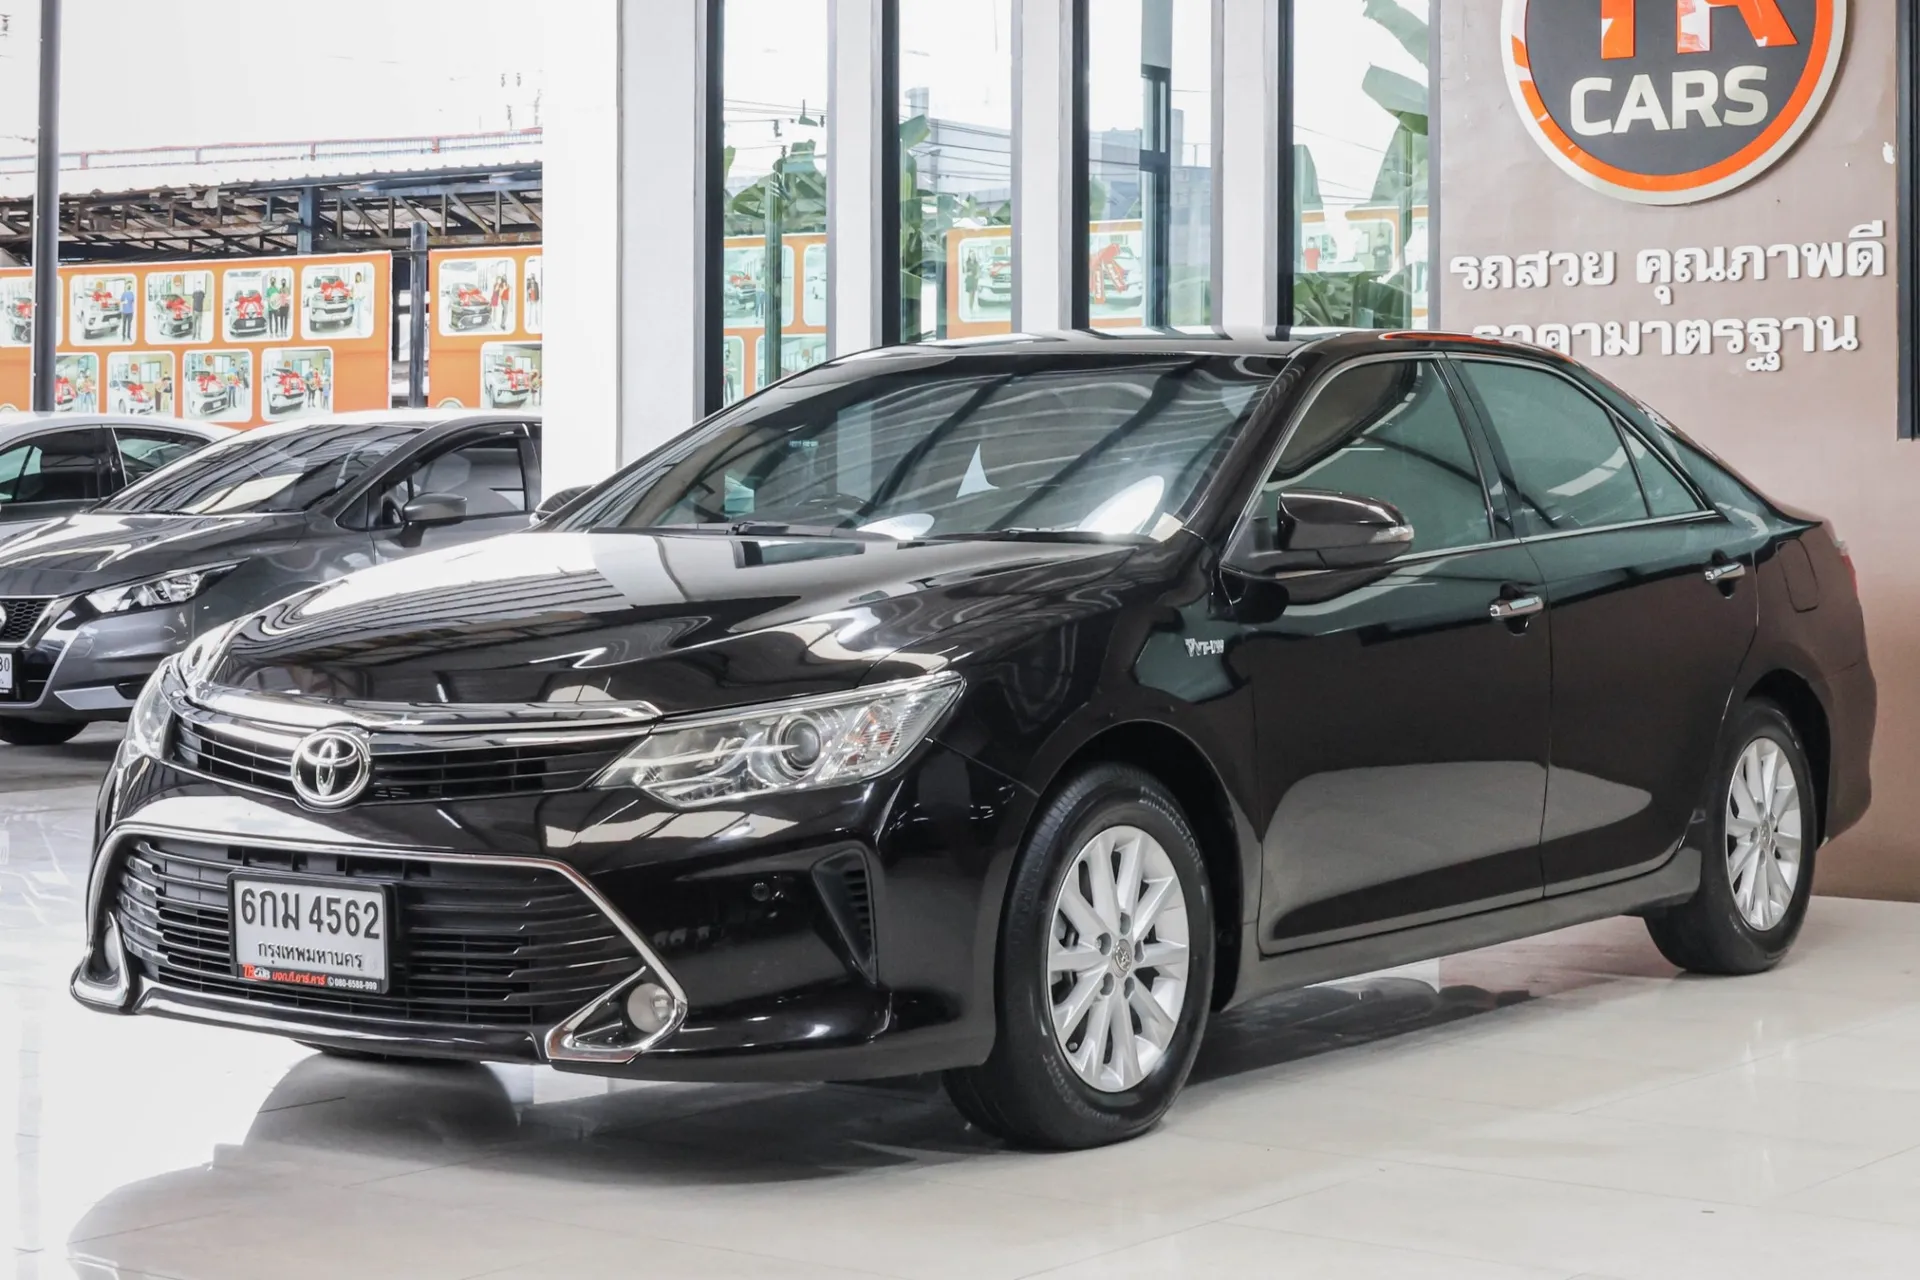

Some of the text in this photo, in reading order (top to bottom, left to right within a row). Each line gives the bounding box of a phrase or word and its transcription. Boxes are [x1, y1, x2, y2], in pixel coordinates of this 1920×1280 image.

[1570, 65, 1769, 137] CARS
[1450, 220, 1886, 305] รถสวย คุณภาพดี
[241, 887, 380, 940] 6กม 4562
[257, 942, 363, 969] กรุงเทพมหานคร
